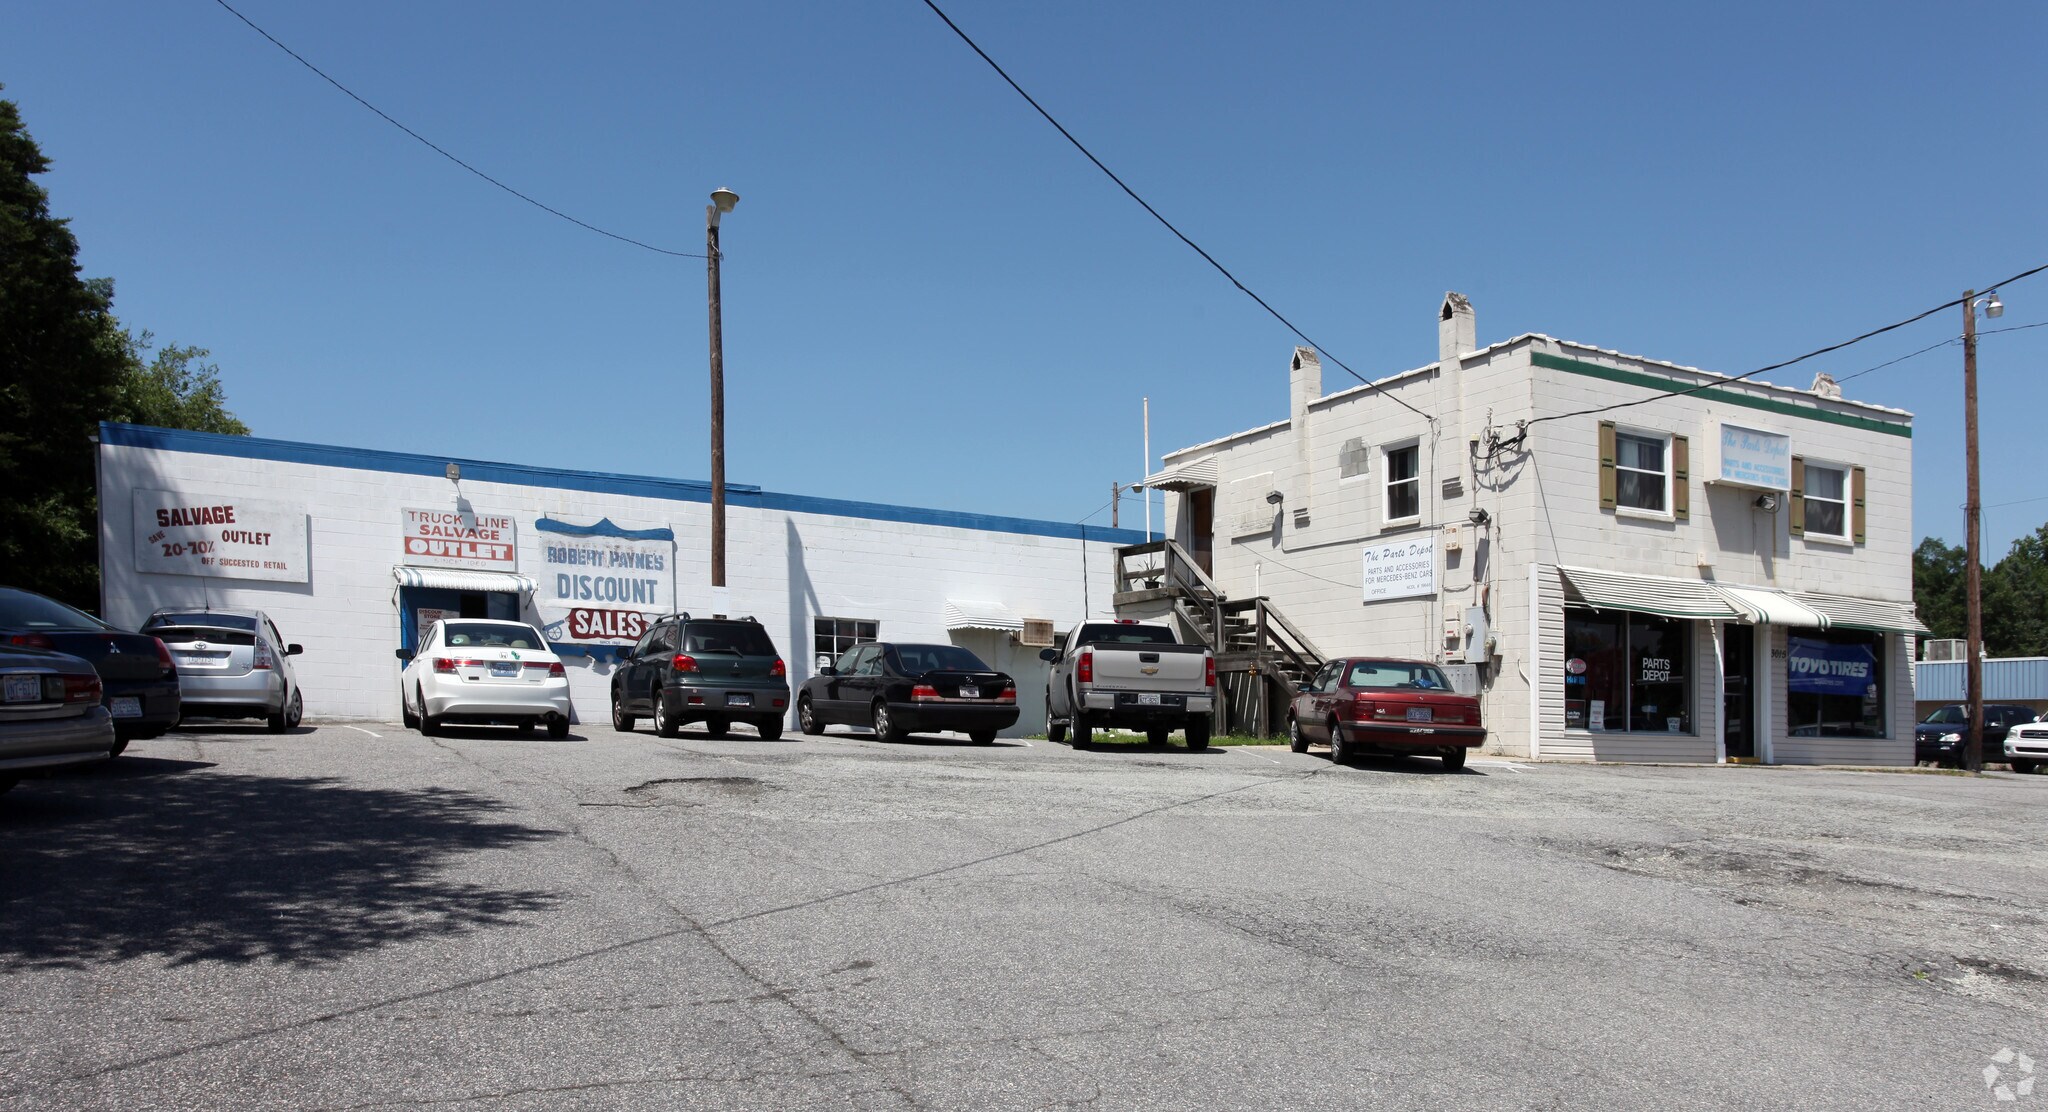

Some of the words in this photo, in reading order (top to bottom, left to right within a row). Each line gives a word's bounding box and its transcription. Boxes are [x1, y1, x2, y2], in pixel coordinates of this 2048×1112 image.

[157, 506, 235, 527] SALVAGE
[408, 511, 463, 525] TRUCK
[476, 516, 509, 529] LINE
[148, 530, 166, 544] SAVE
[222, 530, 271, 545] OUTLET
[419, 525, 500, 540] SALVAGE
[162, 541, 215, 557] 20-70%
[409, 539, 508, 559] OUTLET
[547, 546, 604, 567] ROBERT
[1364, 551, 1379, 563] The
[1383, 548, 1405, 560] Parts
[1409, 544, 1433, 557] Depot
[201, 557, 215, 565] OFF
[263, 561, 288, 570] RETAIL
[1367, 566, 1383, 575] PARTS
[1384, 565, 1394, 573] AND
[1395, 560, 1430, 572] ACCESSORIES
[557, 573, 658, 604] DISCOUNT
[575, 609, 642, 638] SALES
[1642, 657, 1670, 670] PARTS
[1790, 656, 1830, 675] TOYO
[1830, 660, 1869, 678] TIRES
[1642, 670, 1670, 682] DEPOT
